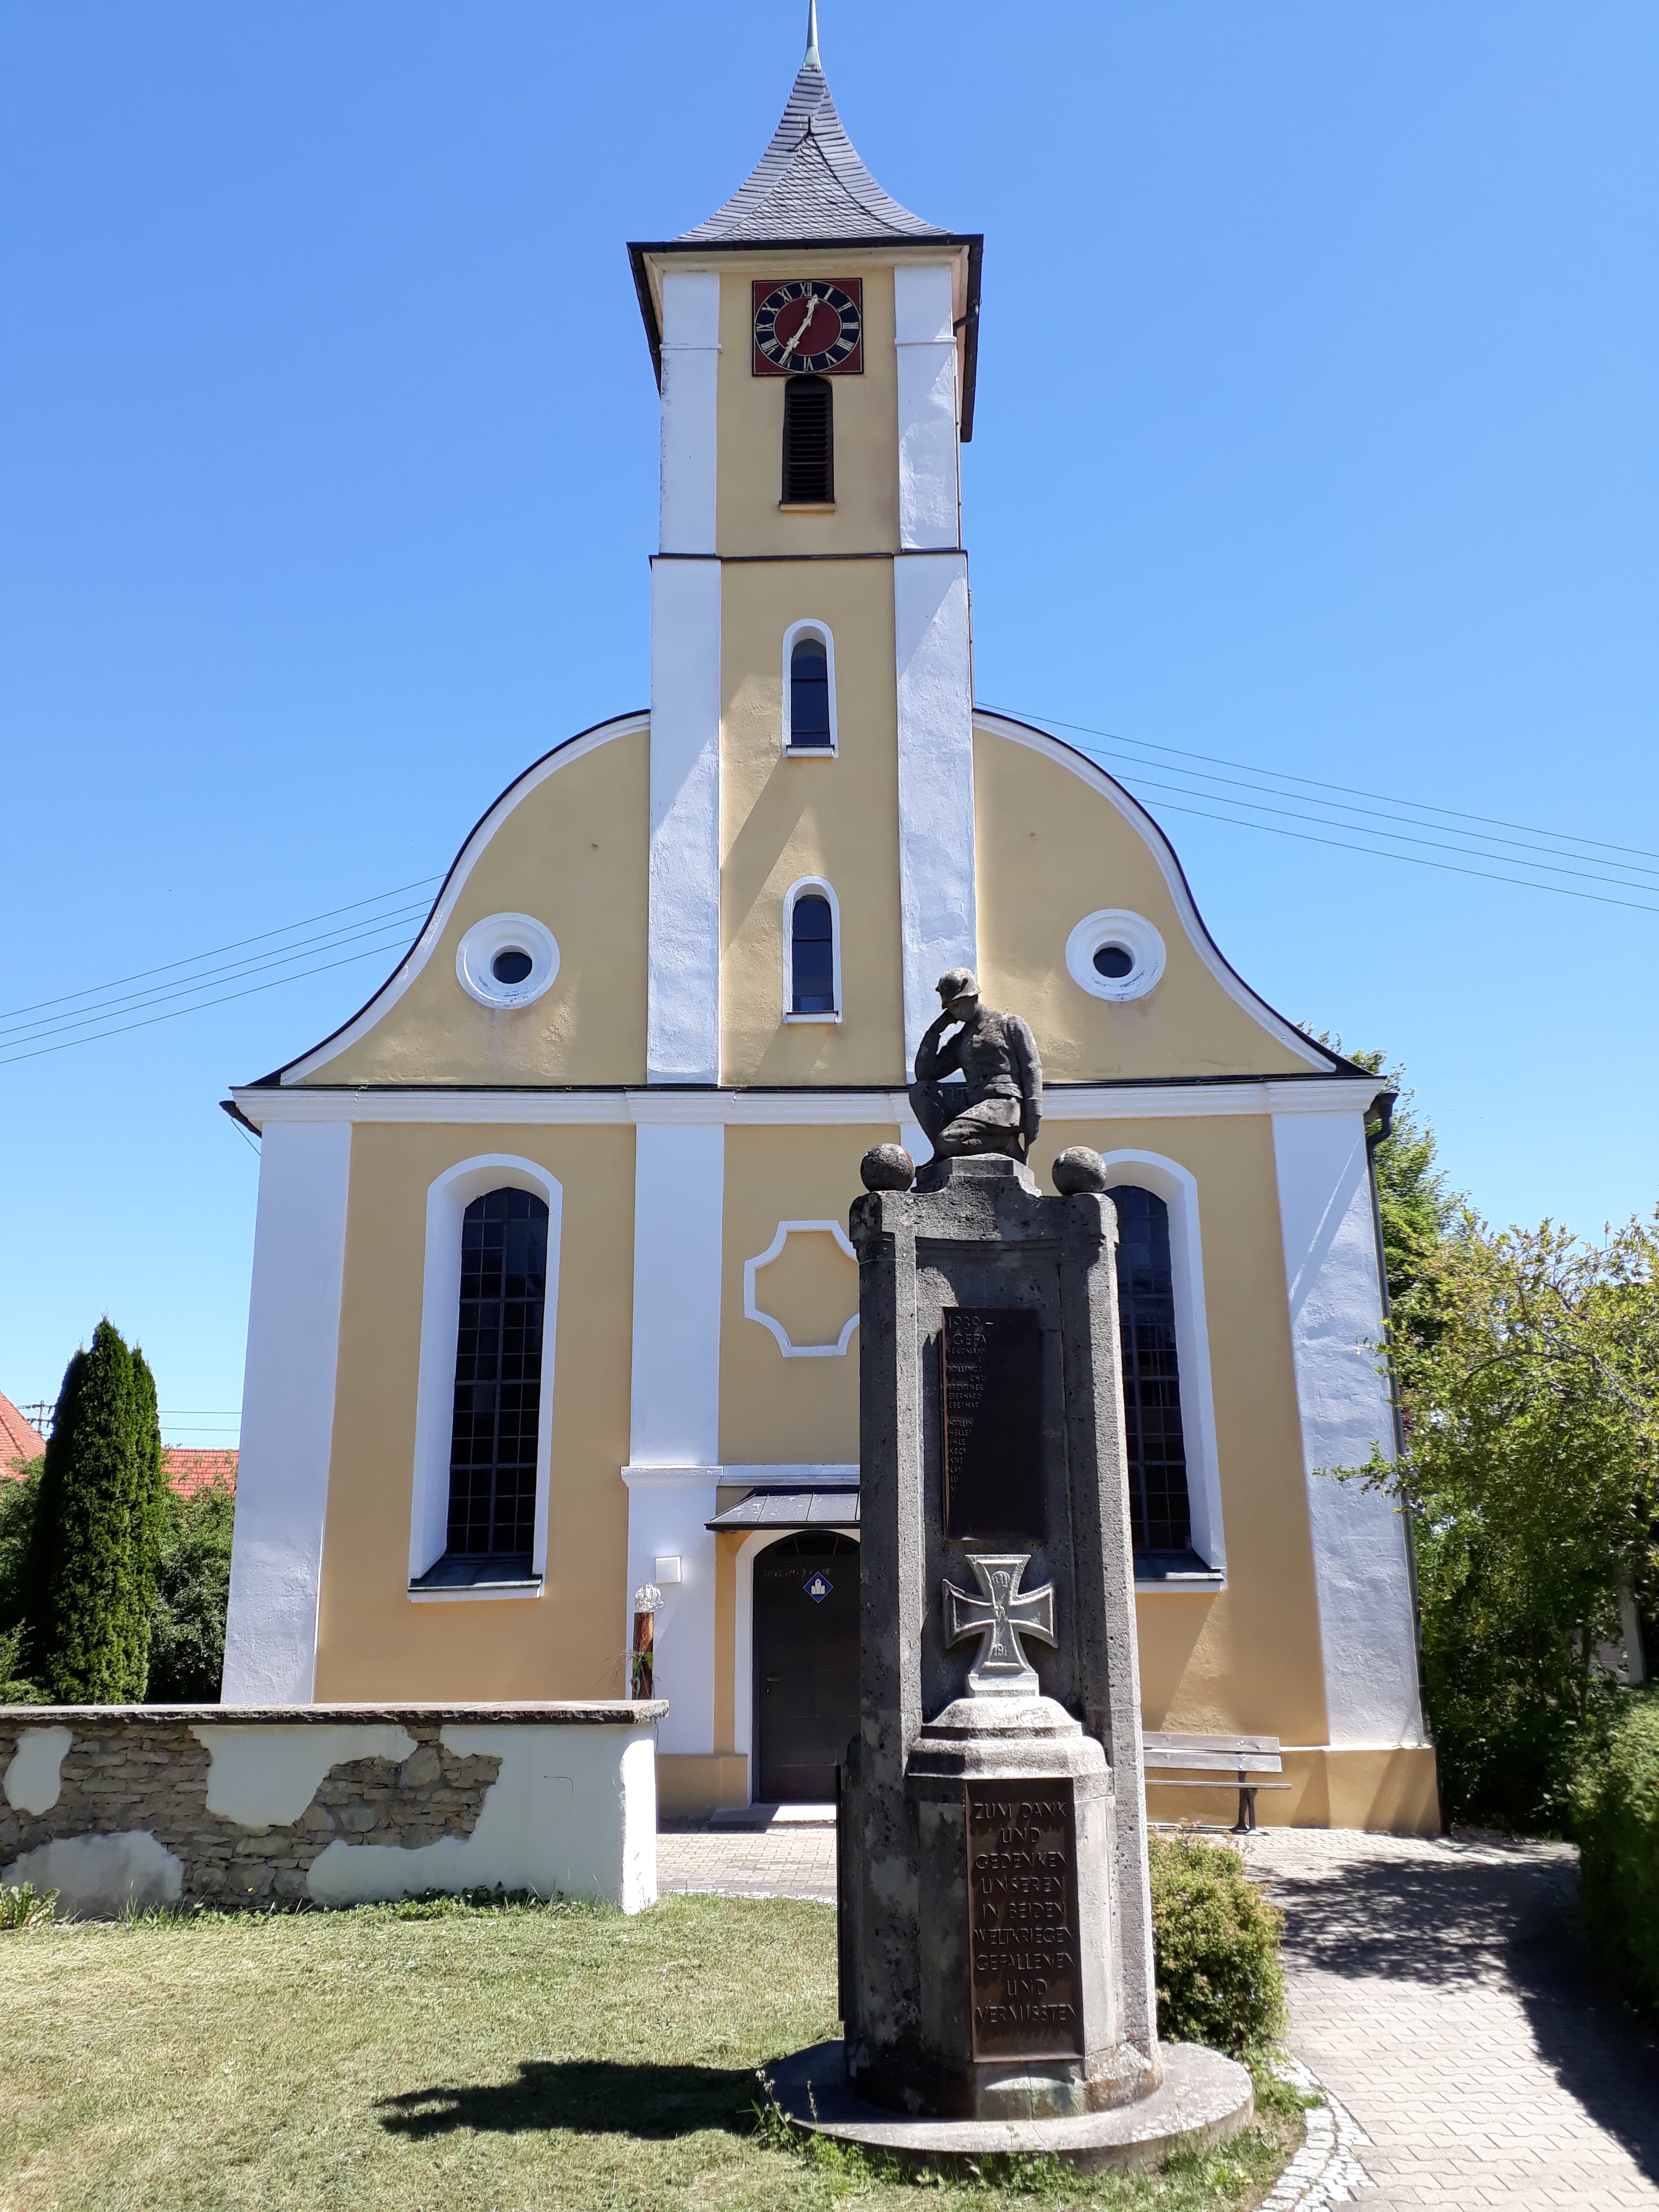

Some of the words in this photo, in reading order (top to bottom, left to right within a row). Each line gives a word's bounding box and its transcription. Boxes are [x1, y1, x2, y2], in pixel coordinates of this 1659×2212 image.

[778, 287, 793, 304] XI
[799, 282, 812, 297] XII
[761, 302, 780, 315] X
[756, 323, 773, 332] IX
[842, 322, 859, 330] III
[803, 356, 814, 371] VI
[973, 1802, 1012, 1820] ZUM
[1021, 1802, 1068, 1819] DANK
[1000, 1827, 1041, 1844] UND
[975, 1851, 1069, 1869] GEDENKEN
[981, 1876, 1064, 1895] UNSEREN
[982, 1903, 1000, 1920] IN
[1008, 1902, 1067, 1919] BEIDEN
[973, 1926, 1076, 1945] WELTKRIEGEN
[975, 1952, 1076, 1971] GEFALLENEN
[1006, 1977, 1048, 1997] UND
[975, 2003, 1079, 2024] VERMISSTEN
